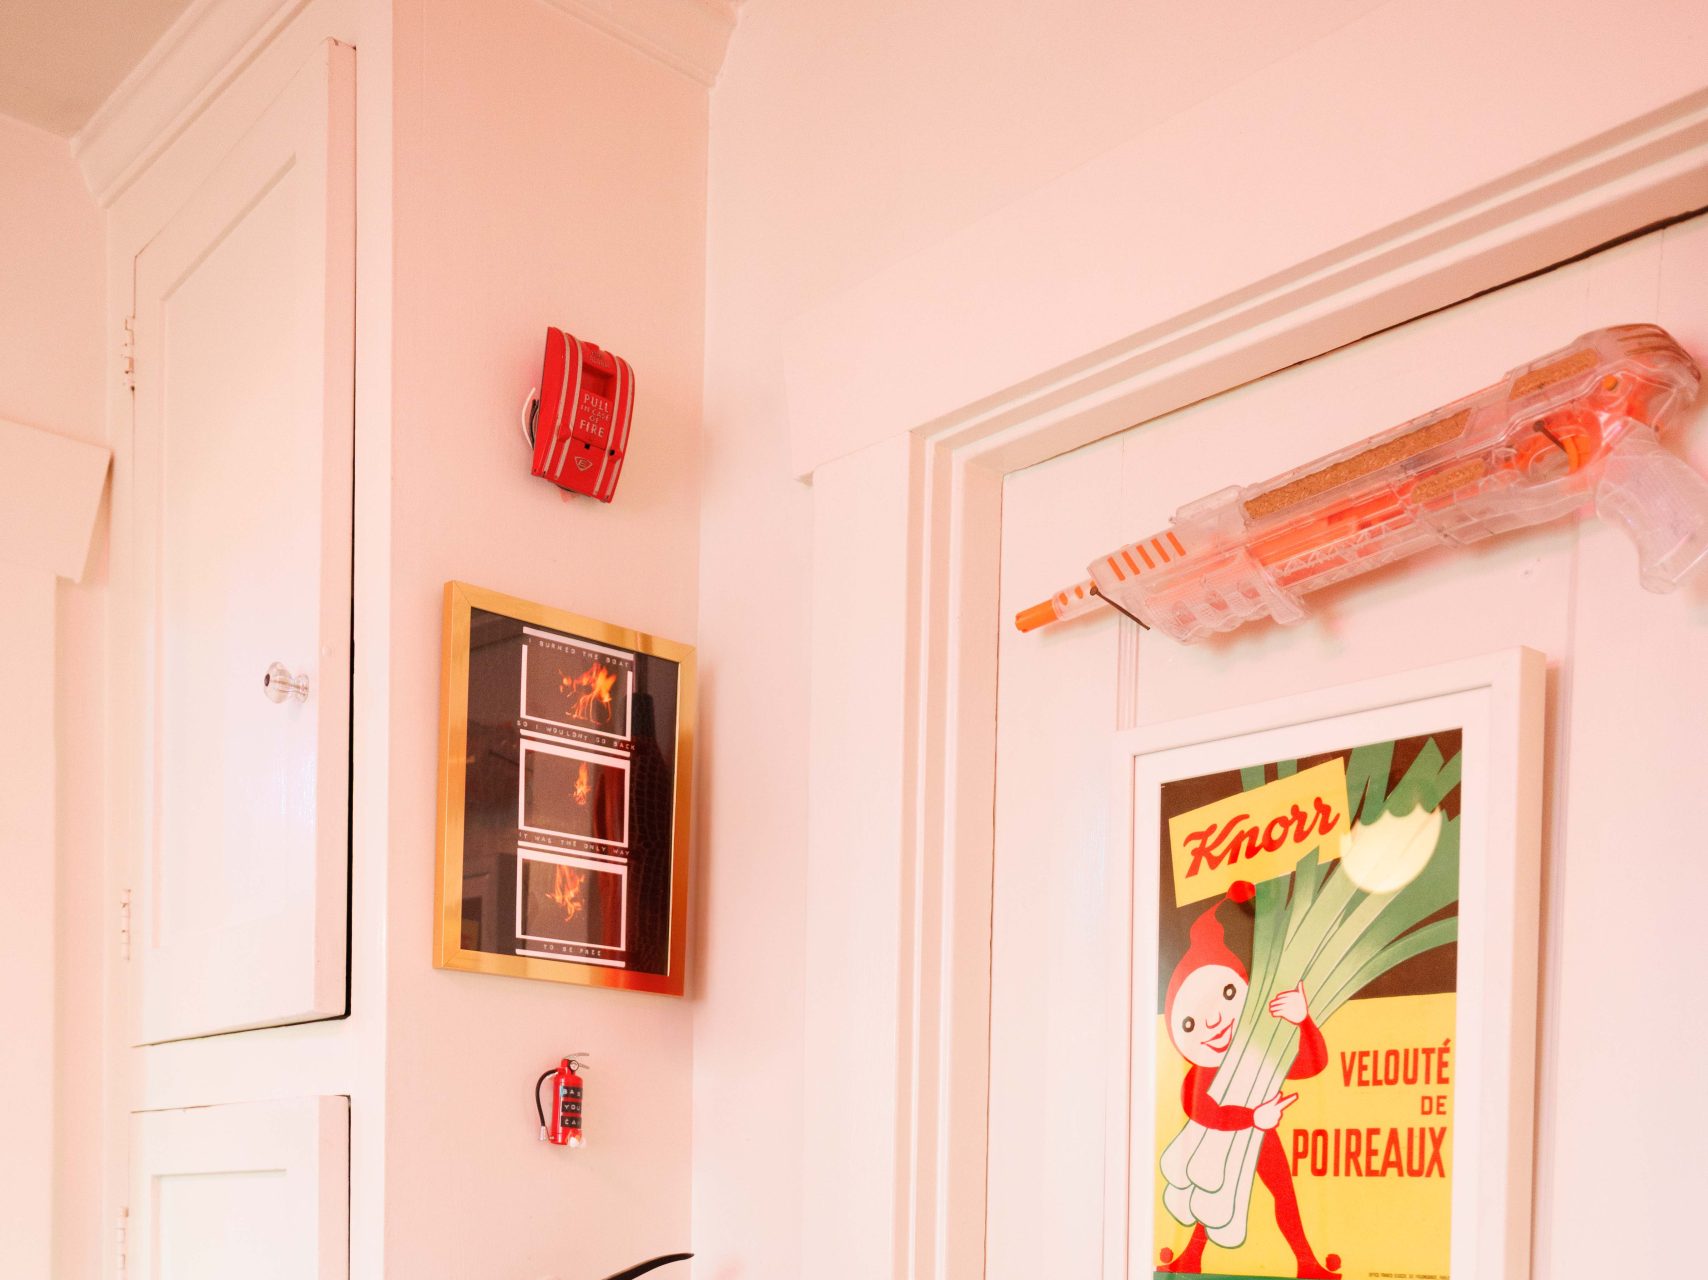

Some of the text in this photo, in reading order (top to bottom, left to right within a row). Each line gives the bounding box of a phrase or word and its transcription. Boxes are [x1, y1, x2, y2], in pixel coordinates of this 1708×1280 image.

[584, 393, 609, 413] PULL
[579, 419, 605, 438] FIRE
[539, 640, 576, 654] BURNED
[582, 651, 599, 660] THE
[613, 741, 635, 750] BACK
[519, 831, 630, 856] IT WAS THE ONLY WAY
[1183, 796, 1341, 879] Knorr
[579, 948, 601, 956] FREE
[1340, 1038, 1451, 1087] VELOUTÉ
[1421, 1095, 1447, 1115] DE
[1291, 1126, 1447, 1178] POIREAUX
